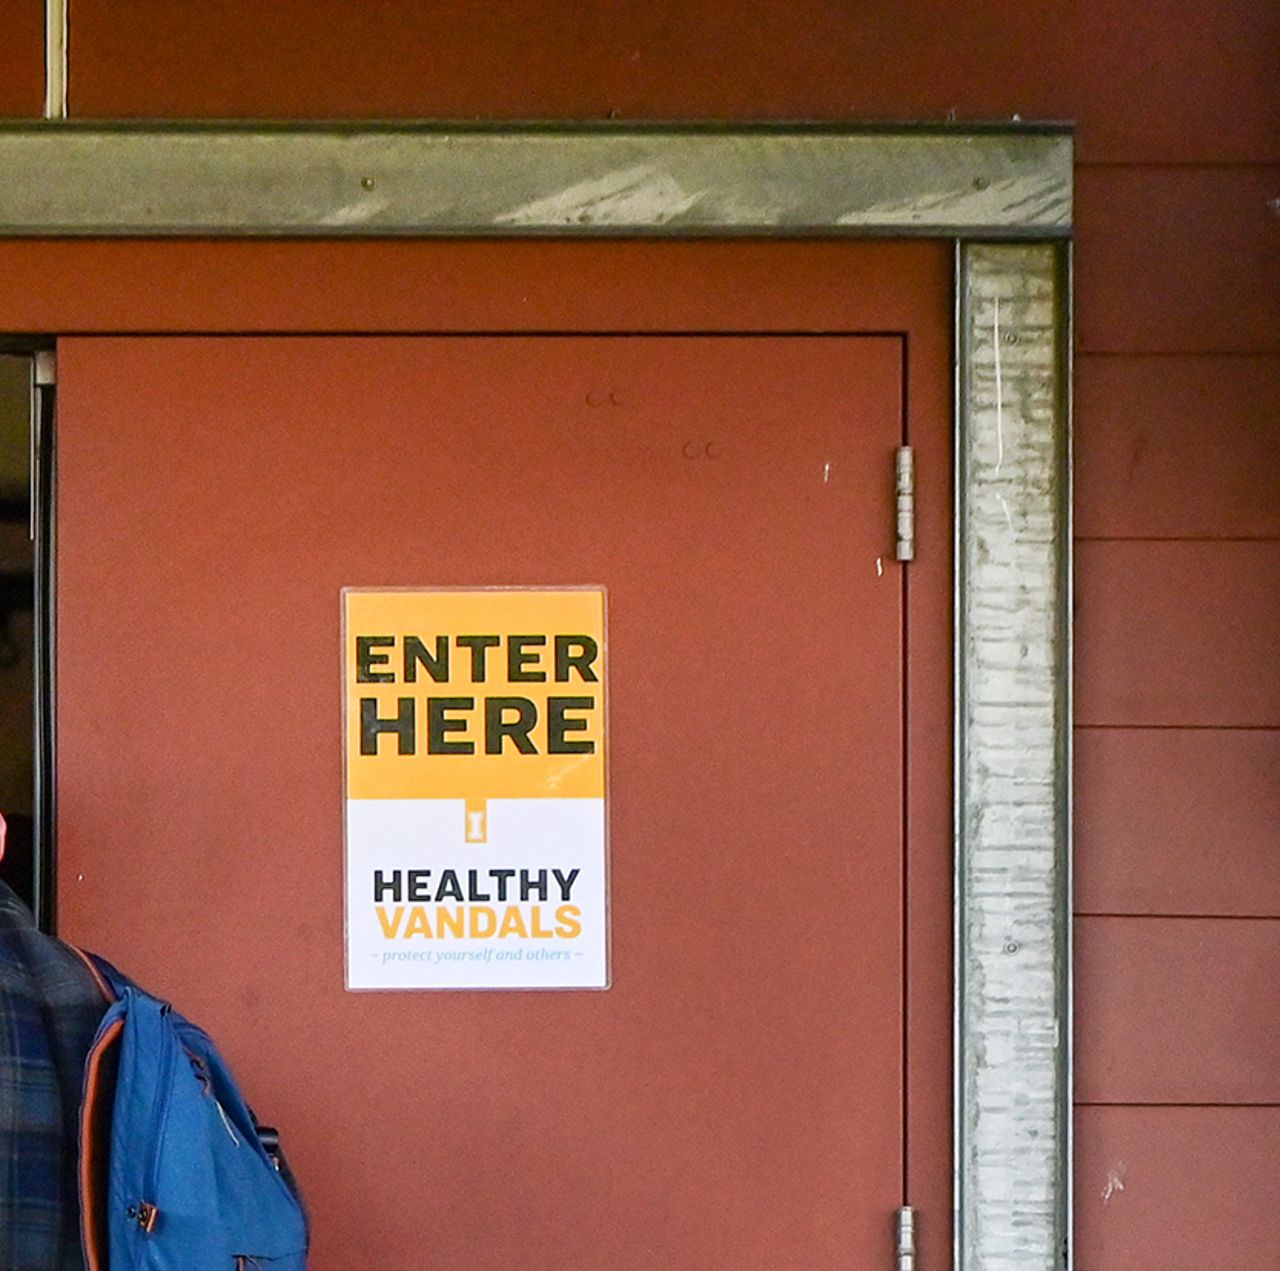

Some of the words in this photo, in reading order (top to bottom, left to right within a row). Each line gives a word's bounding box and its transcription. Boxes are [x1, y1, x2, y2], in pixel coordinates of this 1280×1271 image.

[356, 635, 599, 683] ENTER
[359, 696, 595, 756] HERE
[374, 868, 581, 902] HEALTHY
[375, 905, 582, 939] VANDALS
[382, 949, 432, 964] protect
[435, 948, 495, 964] yourself
[496, 948, 522, 961] and
[526, 948, 571, 961] others
